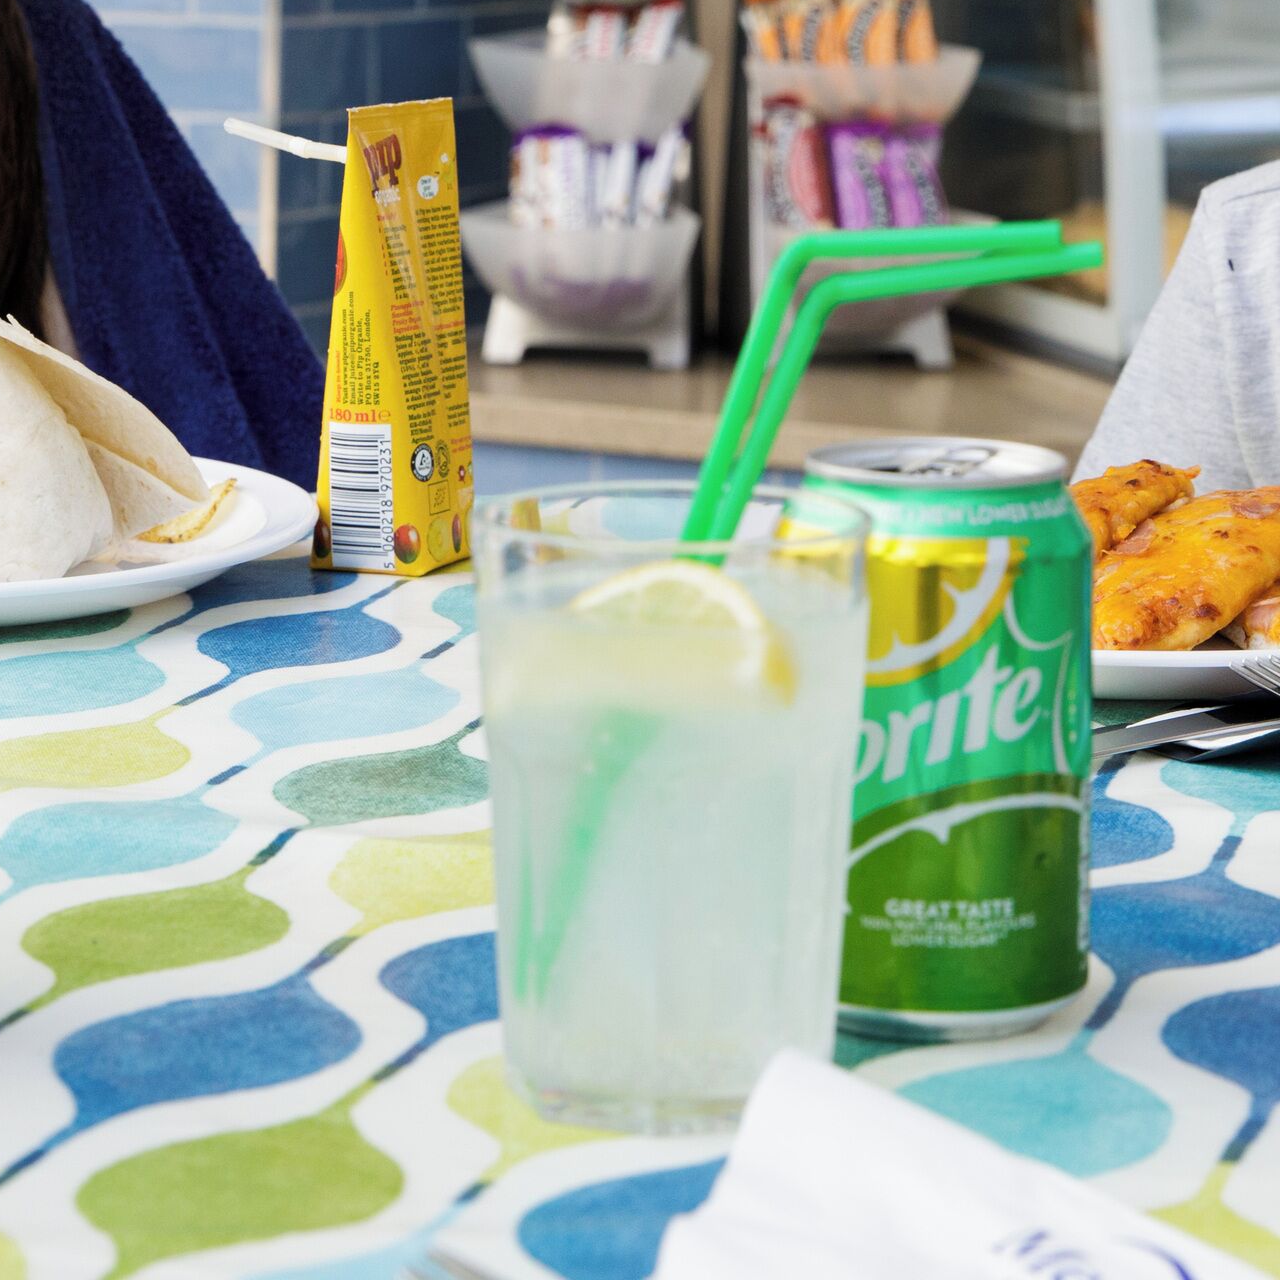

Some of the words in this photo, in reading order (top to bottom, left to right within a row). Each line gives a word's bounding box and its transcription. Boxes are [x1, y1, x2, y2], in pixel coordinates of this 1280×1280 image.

[363, 134, 402, 199] pip
[358, 372, 363, 380] to
[372, 362, 380, 380] 2YQ
[365, 393, 372, 405] PO
[329, 408, 352, 422] 180
[380, 440, 392, 492] 970231
[380, 500, 394, 552] 060218
[884, 898, 951, 920] GREAT
[956, 897, 1015, 920] TASTE
